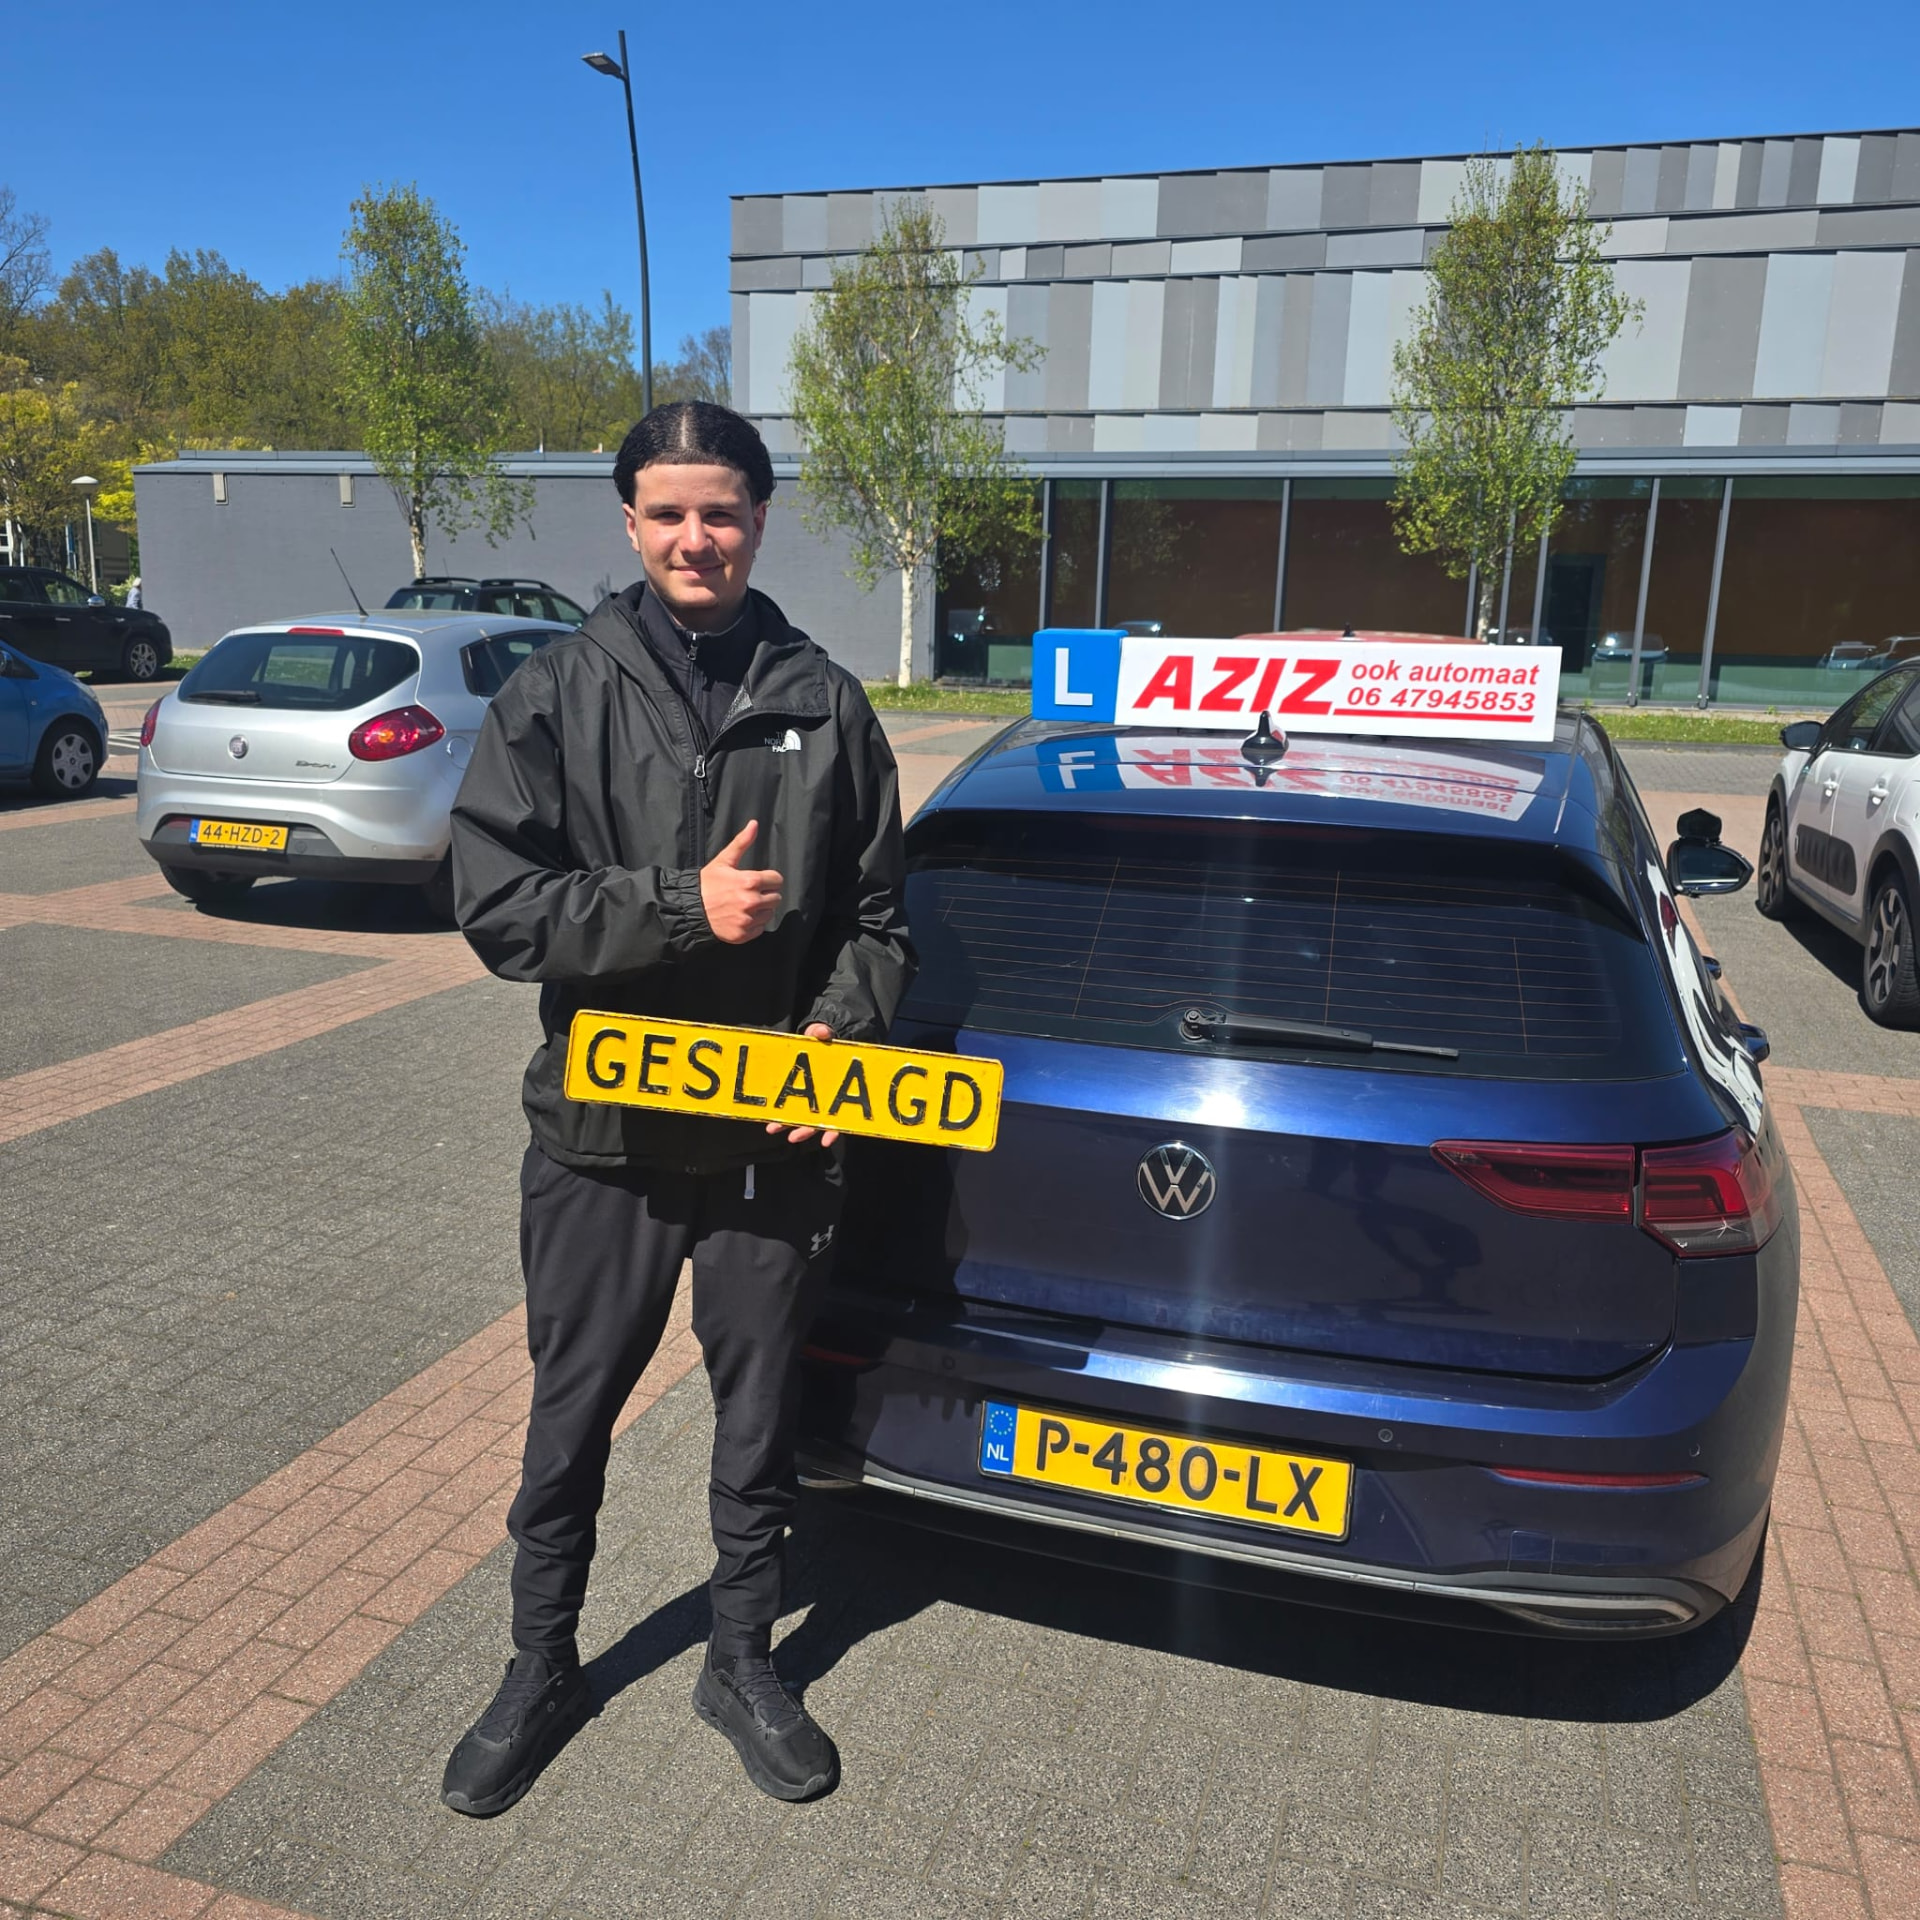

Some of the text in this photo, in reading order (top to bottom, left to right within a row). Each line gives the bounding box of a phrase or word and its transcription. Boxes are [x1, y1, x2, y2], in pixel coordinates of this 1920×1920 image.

[1055, 648, 1093, 706] L
[1132, 655, 1342, 716] AZIZ
[1351, 659, 1540, 685] ook automaat
[1347, 686, 1536, 712] 06 47945853
[203, 824, 281, 846] 44-HZD-2
[585, 1029, 983, 1132] GESLAAGD
[986, 1442, 1009, 1462] NL
[1036, 1418, 1325, 1522] P-480-LX
